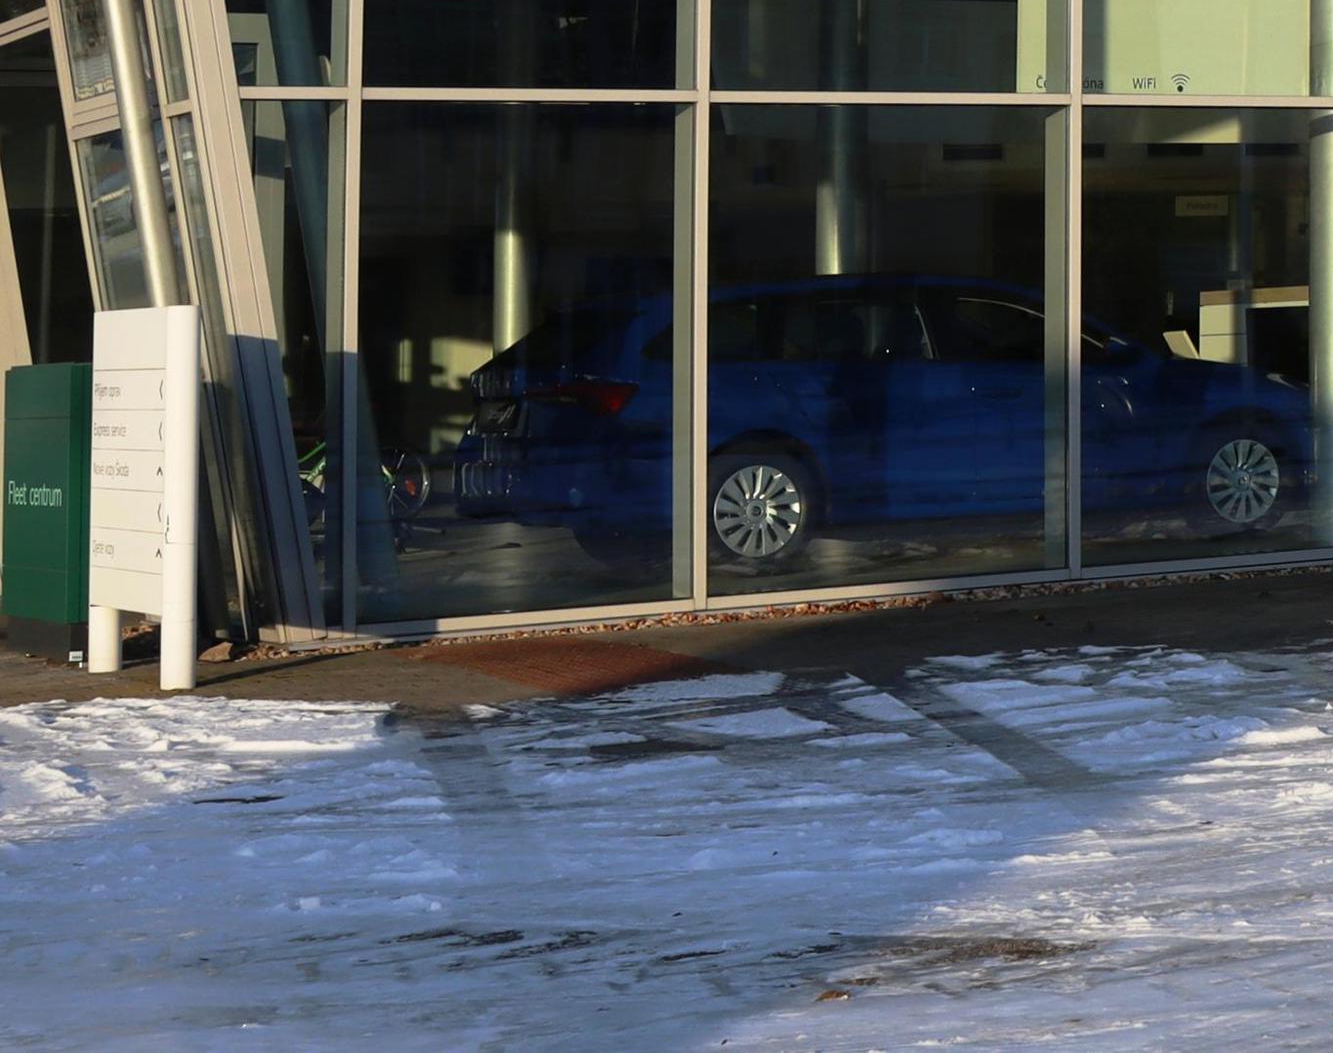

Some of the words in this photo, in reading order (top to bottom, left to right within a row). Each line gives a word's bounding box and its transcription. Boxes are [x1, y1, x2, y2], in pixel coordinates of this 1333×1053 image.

[1132, 77, 1157, 90] WiFi
[8, 480, 27, 506] Fleet
[29, 482, 63, 507] centrum
